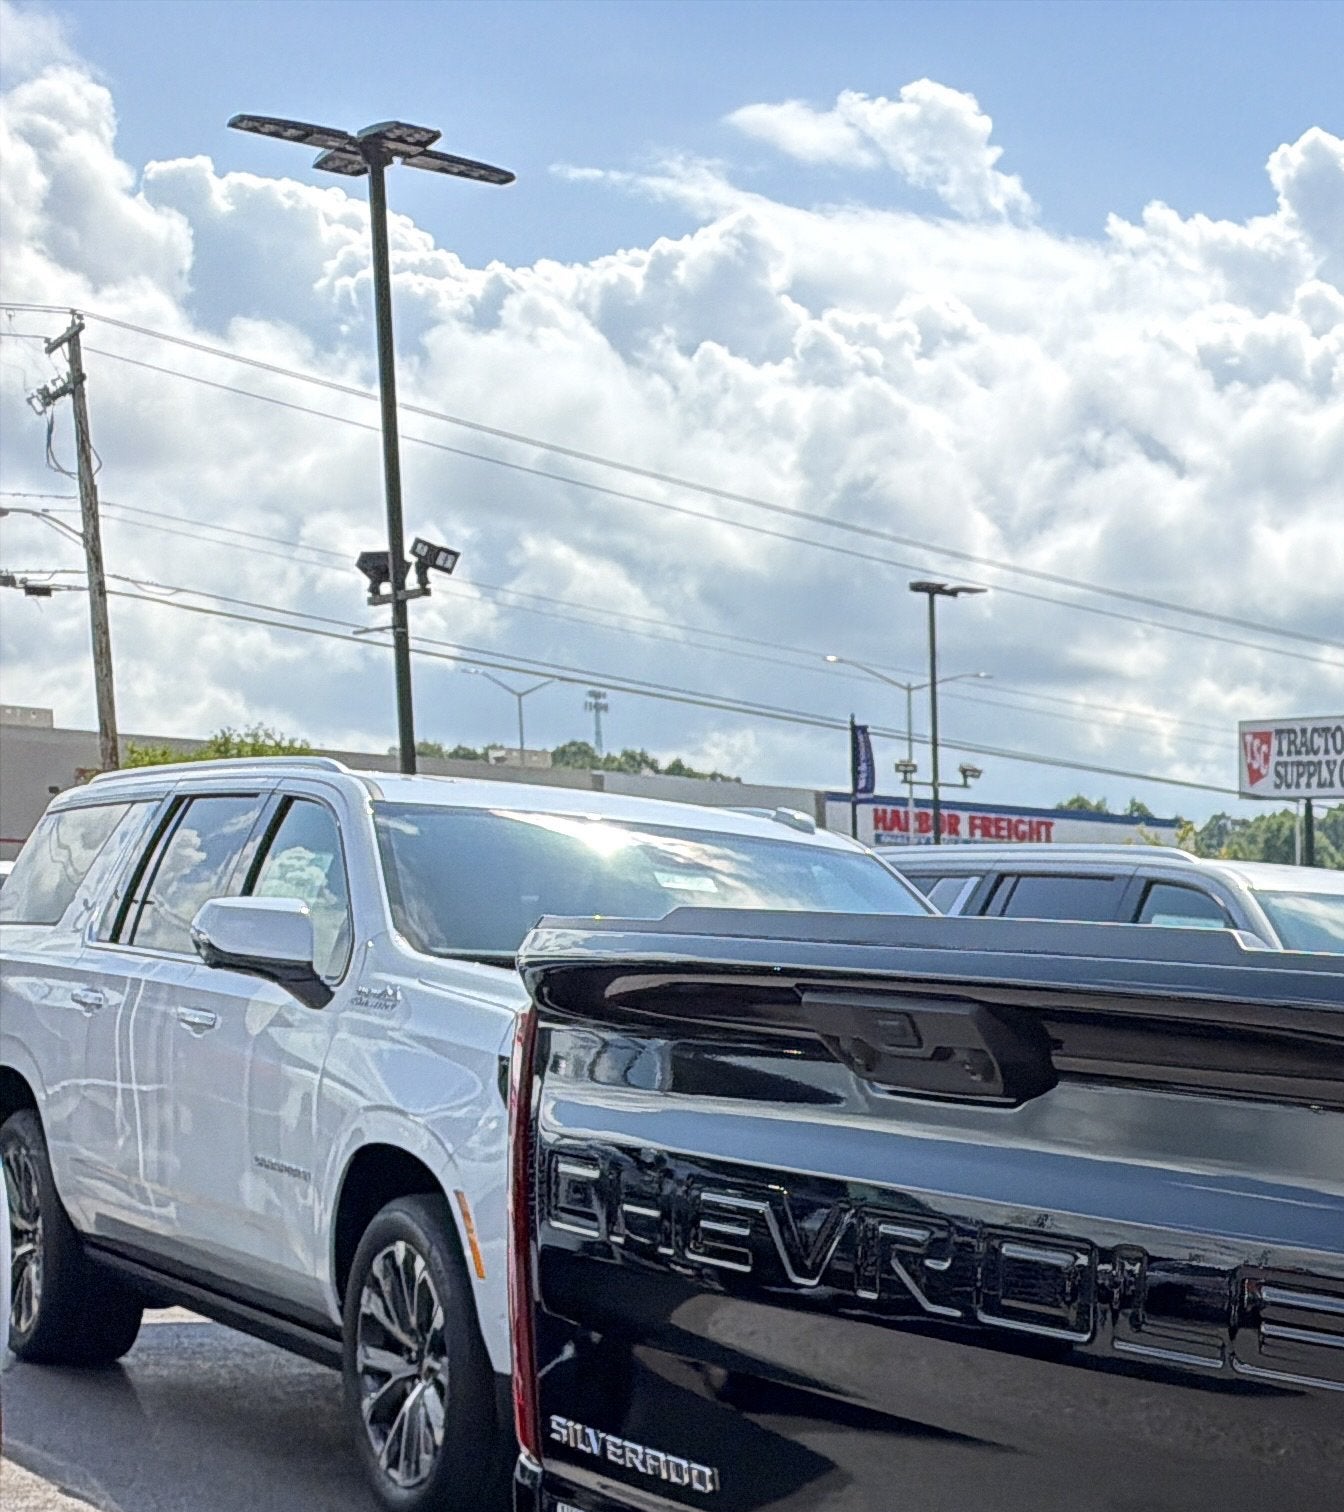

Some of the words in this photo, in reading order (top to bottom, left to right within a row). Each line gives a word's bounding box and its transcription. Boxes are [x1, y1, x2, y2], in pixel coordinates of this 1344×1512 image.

[1274, 760, 1337, 790] SUPPLY
[968, 815, 1055, 843] FREIGHT
[549, 1414, 718, 1493] SILVERADO
